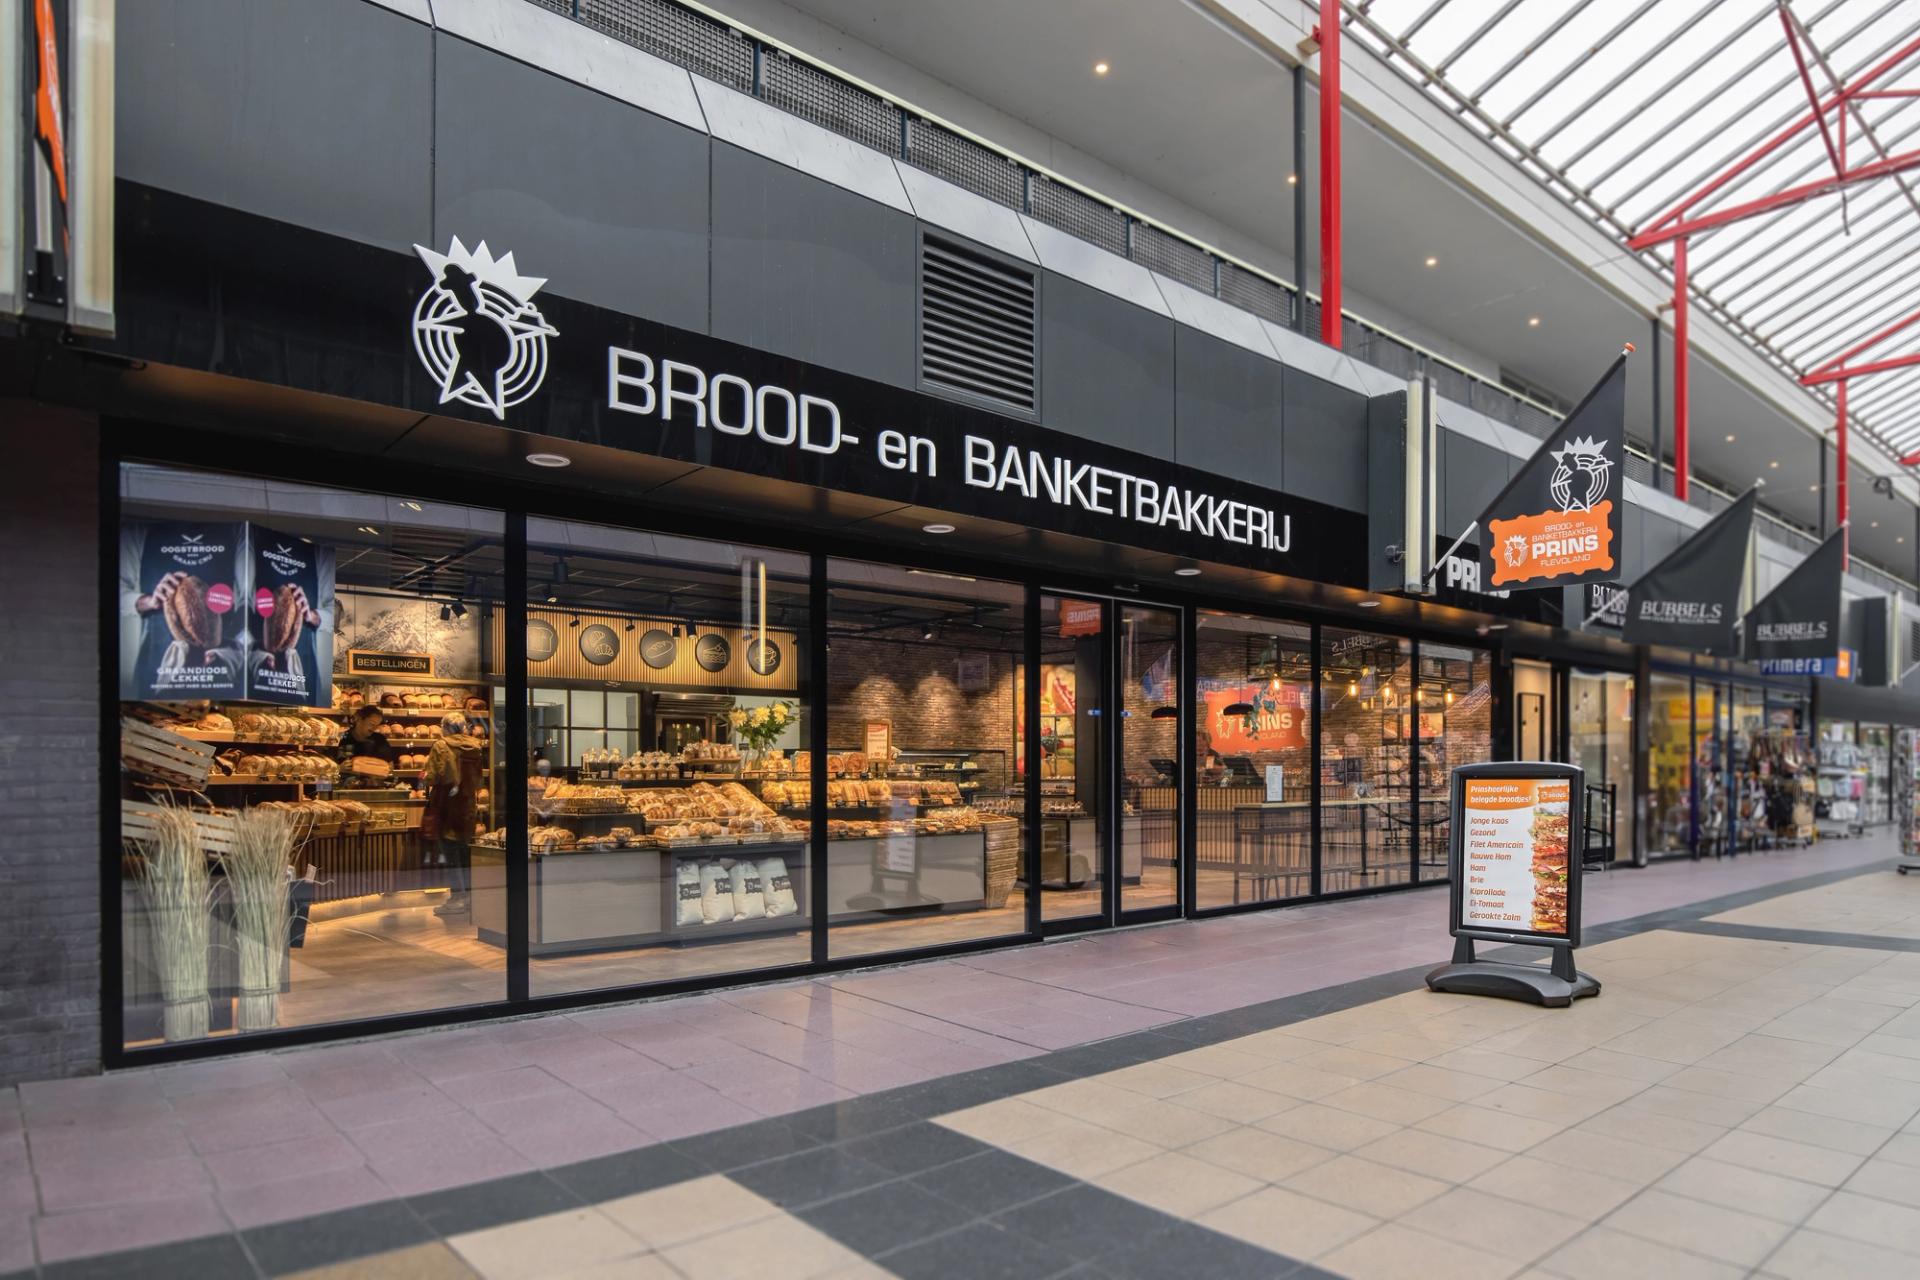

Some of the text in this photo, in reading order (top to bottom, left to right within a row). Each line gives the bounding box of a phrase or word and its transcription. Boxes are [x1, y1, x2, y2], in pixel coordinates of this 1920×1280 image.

[608, 345, 1291, 552] BROOD- en BANKETBAKKERIJ
[1531, 526, 1598, 543] BANKETBAKKERIJ
[160, 545, 225, 554] OOGSTBROOD
[1531, 534, 1599, 560] PRINS
[262, 550, 306, 569] OOGSTBROOD
[1540, 553, 1591, 566] FLEVOLAND
[1640, 600, 1723, 618] BUBBELS
[357, 658, 427, 670] BESTELLINGEN
[156, 666, 228, 675] GRAANDIOOS
[258, 668, 306, 683] GRAANDIOOS
[171, 674, 214, 683] LEKKER
[267, 678, 297, 689] LEKKER
[1470, 785, 1519, 794] Prinsheerlijke
[1470, 795, 1498, 804] belegde
[1470, 817, 1490, 825] Jonge
[1486, 841, 1524, 849] Americain
[1470, 852, 1495, 860] Rauwe
[1470, 864, 1486, 872] Ham
[1470, 875, 1484, 883] Brie
[1469, 887, 1506, 897] Kiprollade
[1469, 911, 1522, 921] Gerookte Zalm
